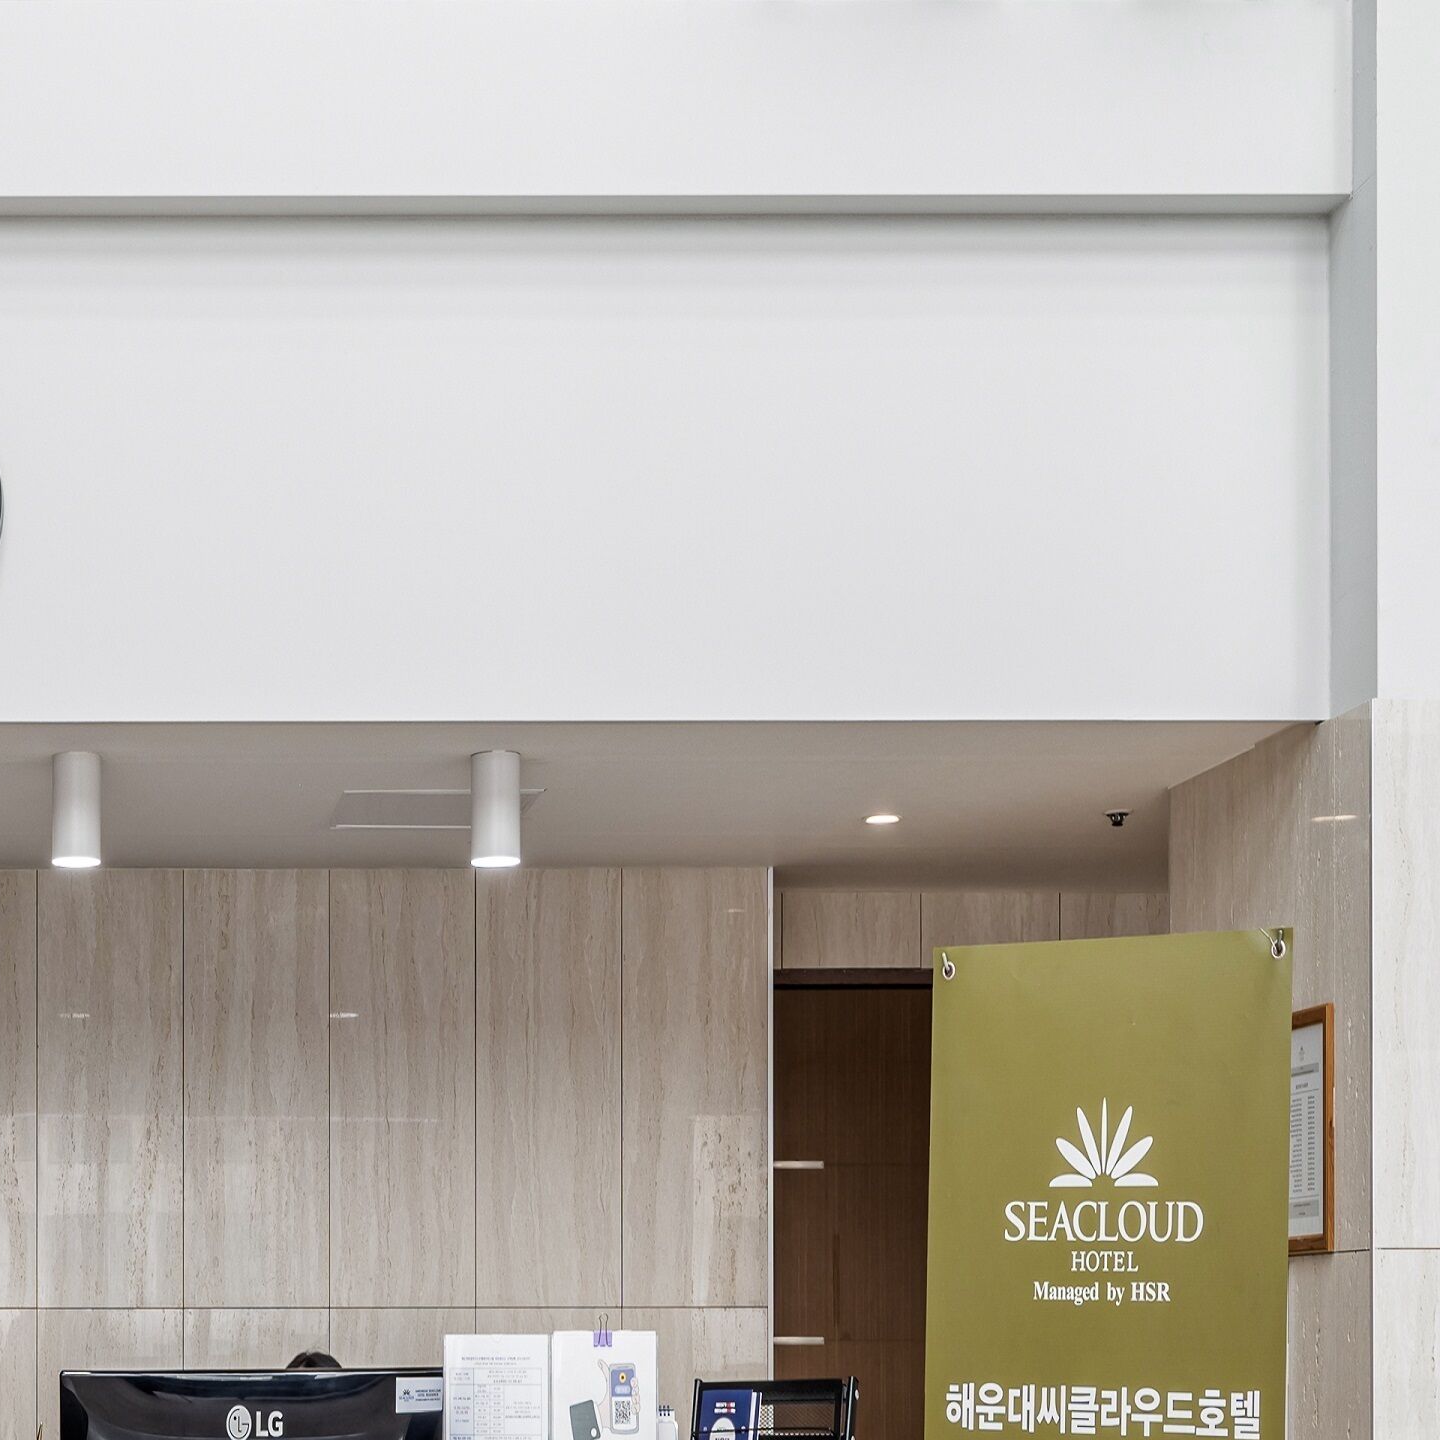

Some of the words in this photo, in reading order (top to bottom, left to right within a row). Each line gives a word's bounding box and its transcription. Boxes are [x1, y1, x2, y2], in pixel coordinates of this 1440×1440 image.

[1004, 1200, 1205, 1243] SEACLOUD
[1071, 1250, 1139, 1272] HOTEL
[1033, 1281, 1099, 1306] Managed
[1107, 1282, 1126, 1306] by
[1130, 1282, 1171, 1301] HSR
[255, 1410, 284, 1437] LG
[946, 1382, 1260, 1440] 해운대씨클라우드호텔
